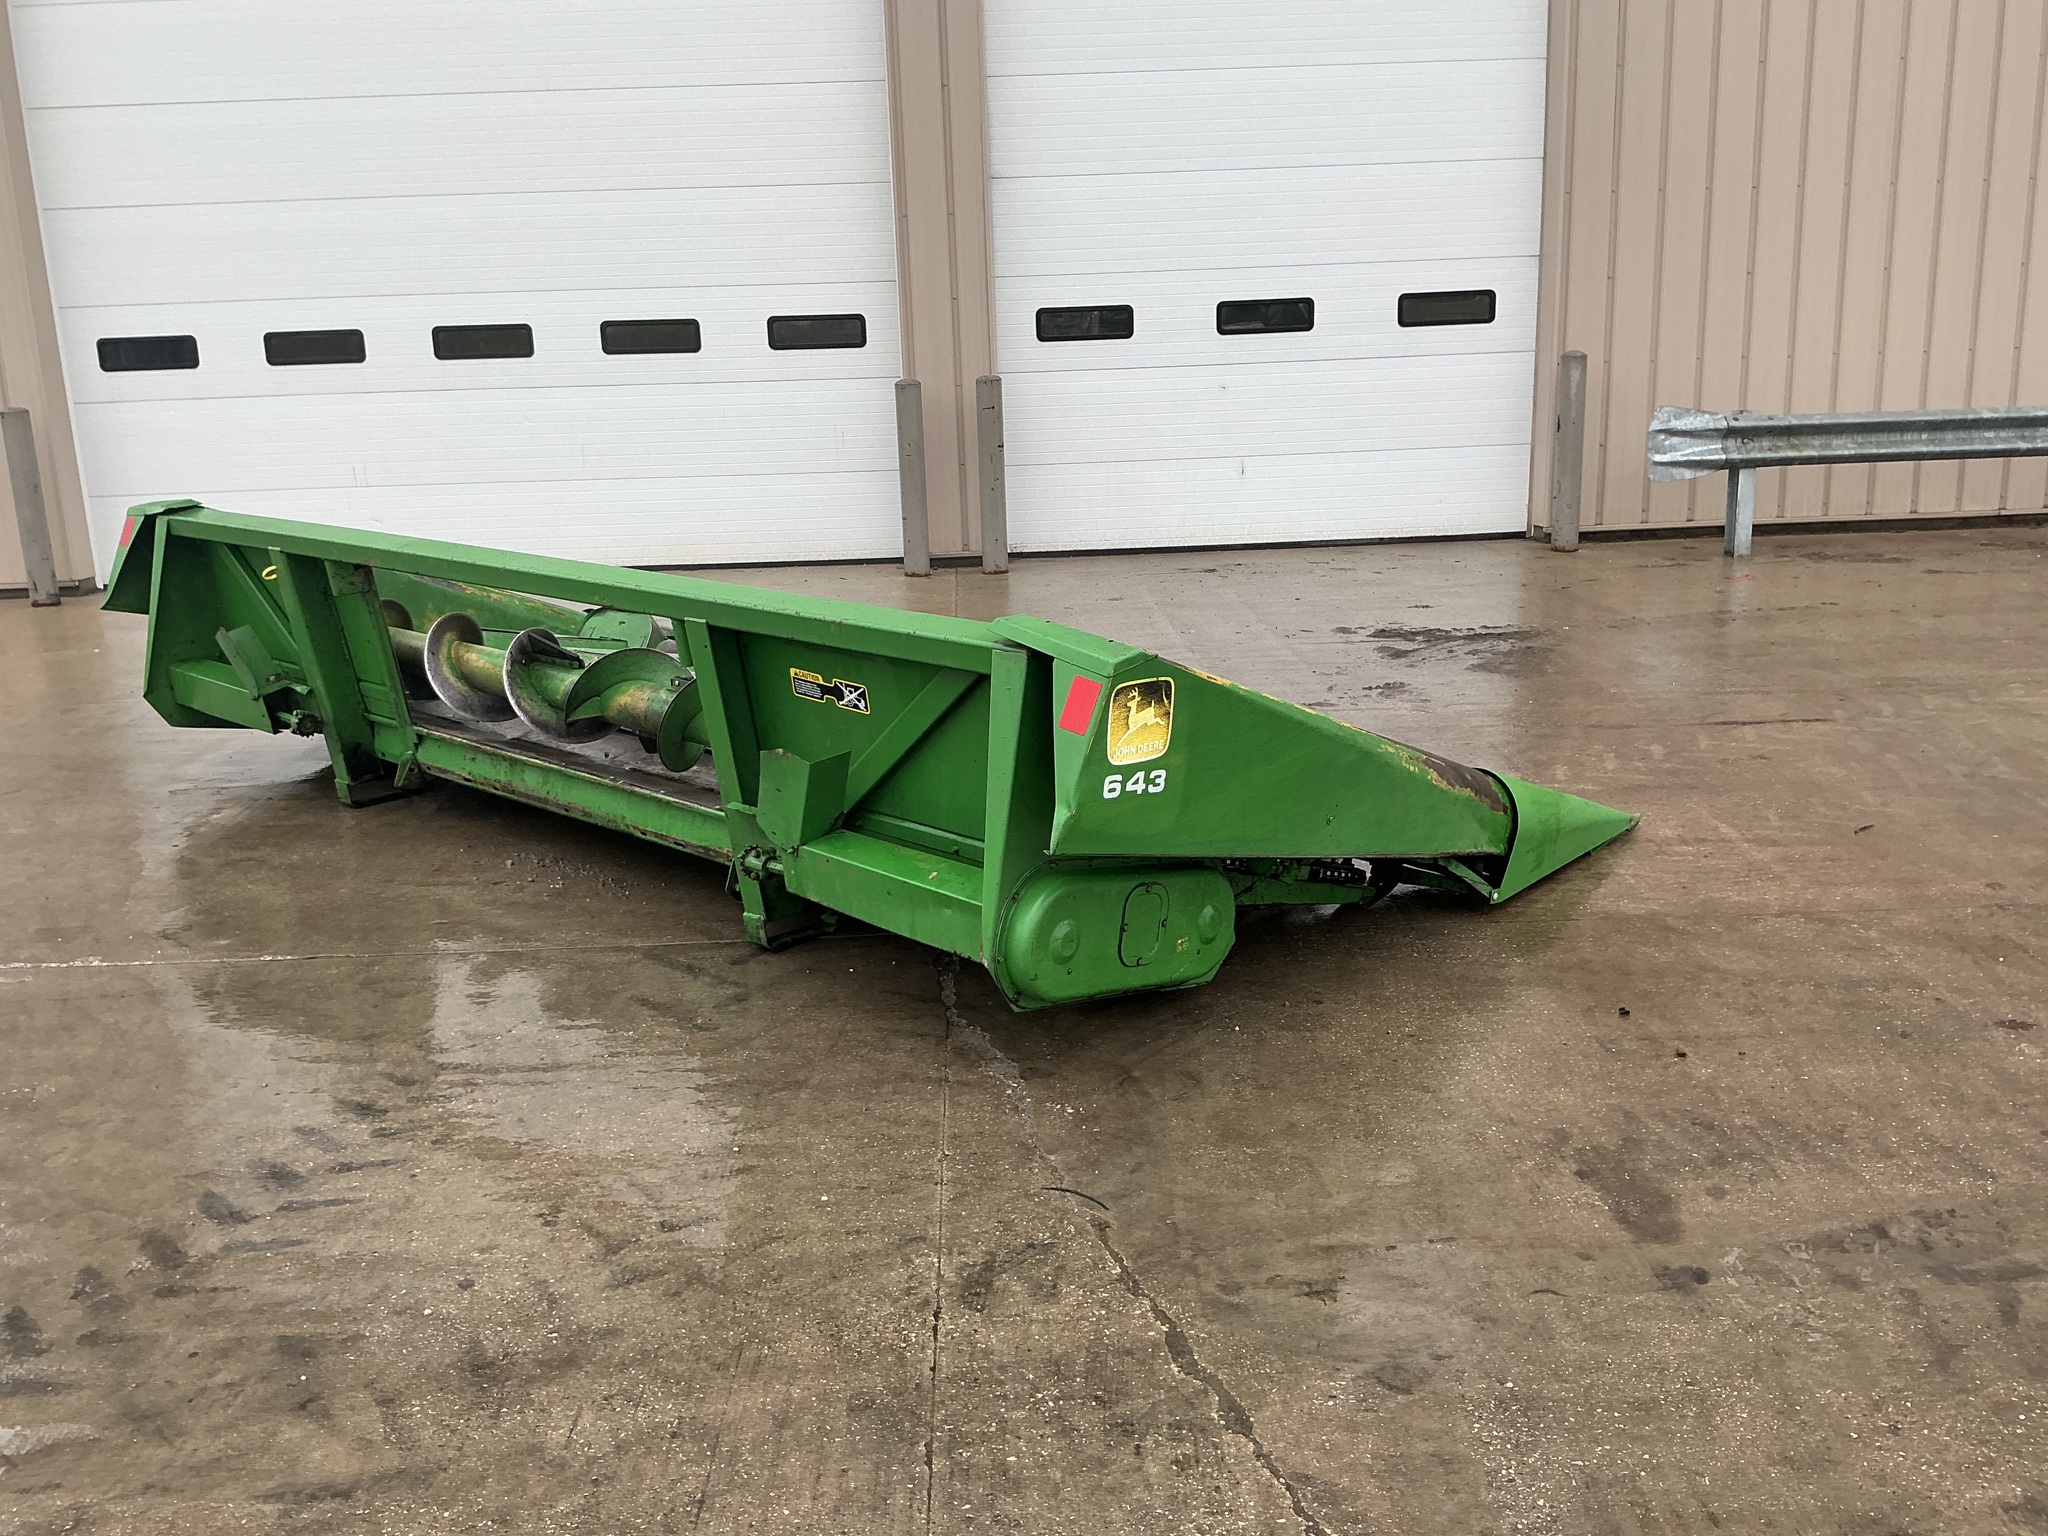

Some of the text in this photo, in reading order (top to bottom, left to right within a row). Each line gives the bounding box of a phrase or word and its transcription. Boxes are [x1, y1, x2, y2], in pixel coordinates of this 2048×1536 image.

[798, 671, 820, 682] CAUTION
[1113, 740, 1164, 758] JOHN DEERE
[1103, 769, 1166, 799] 643
